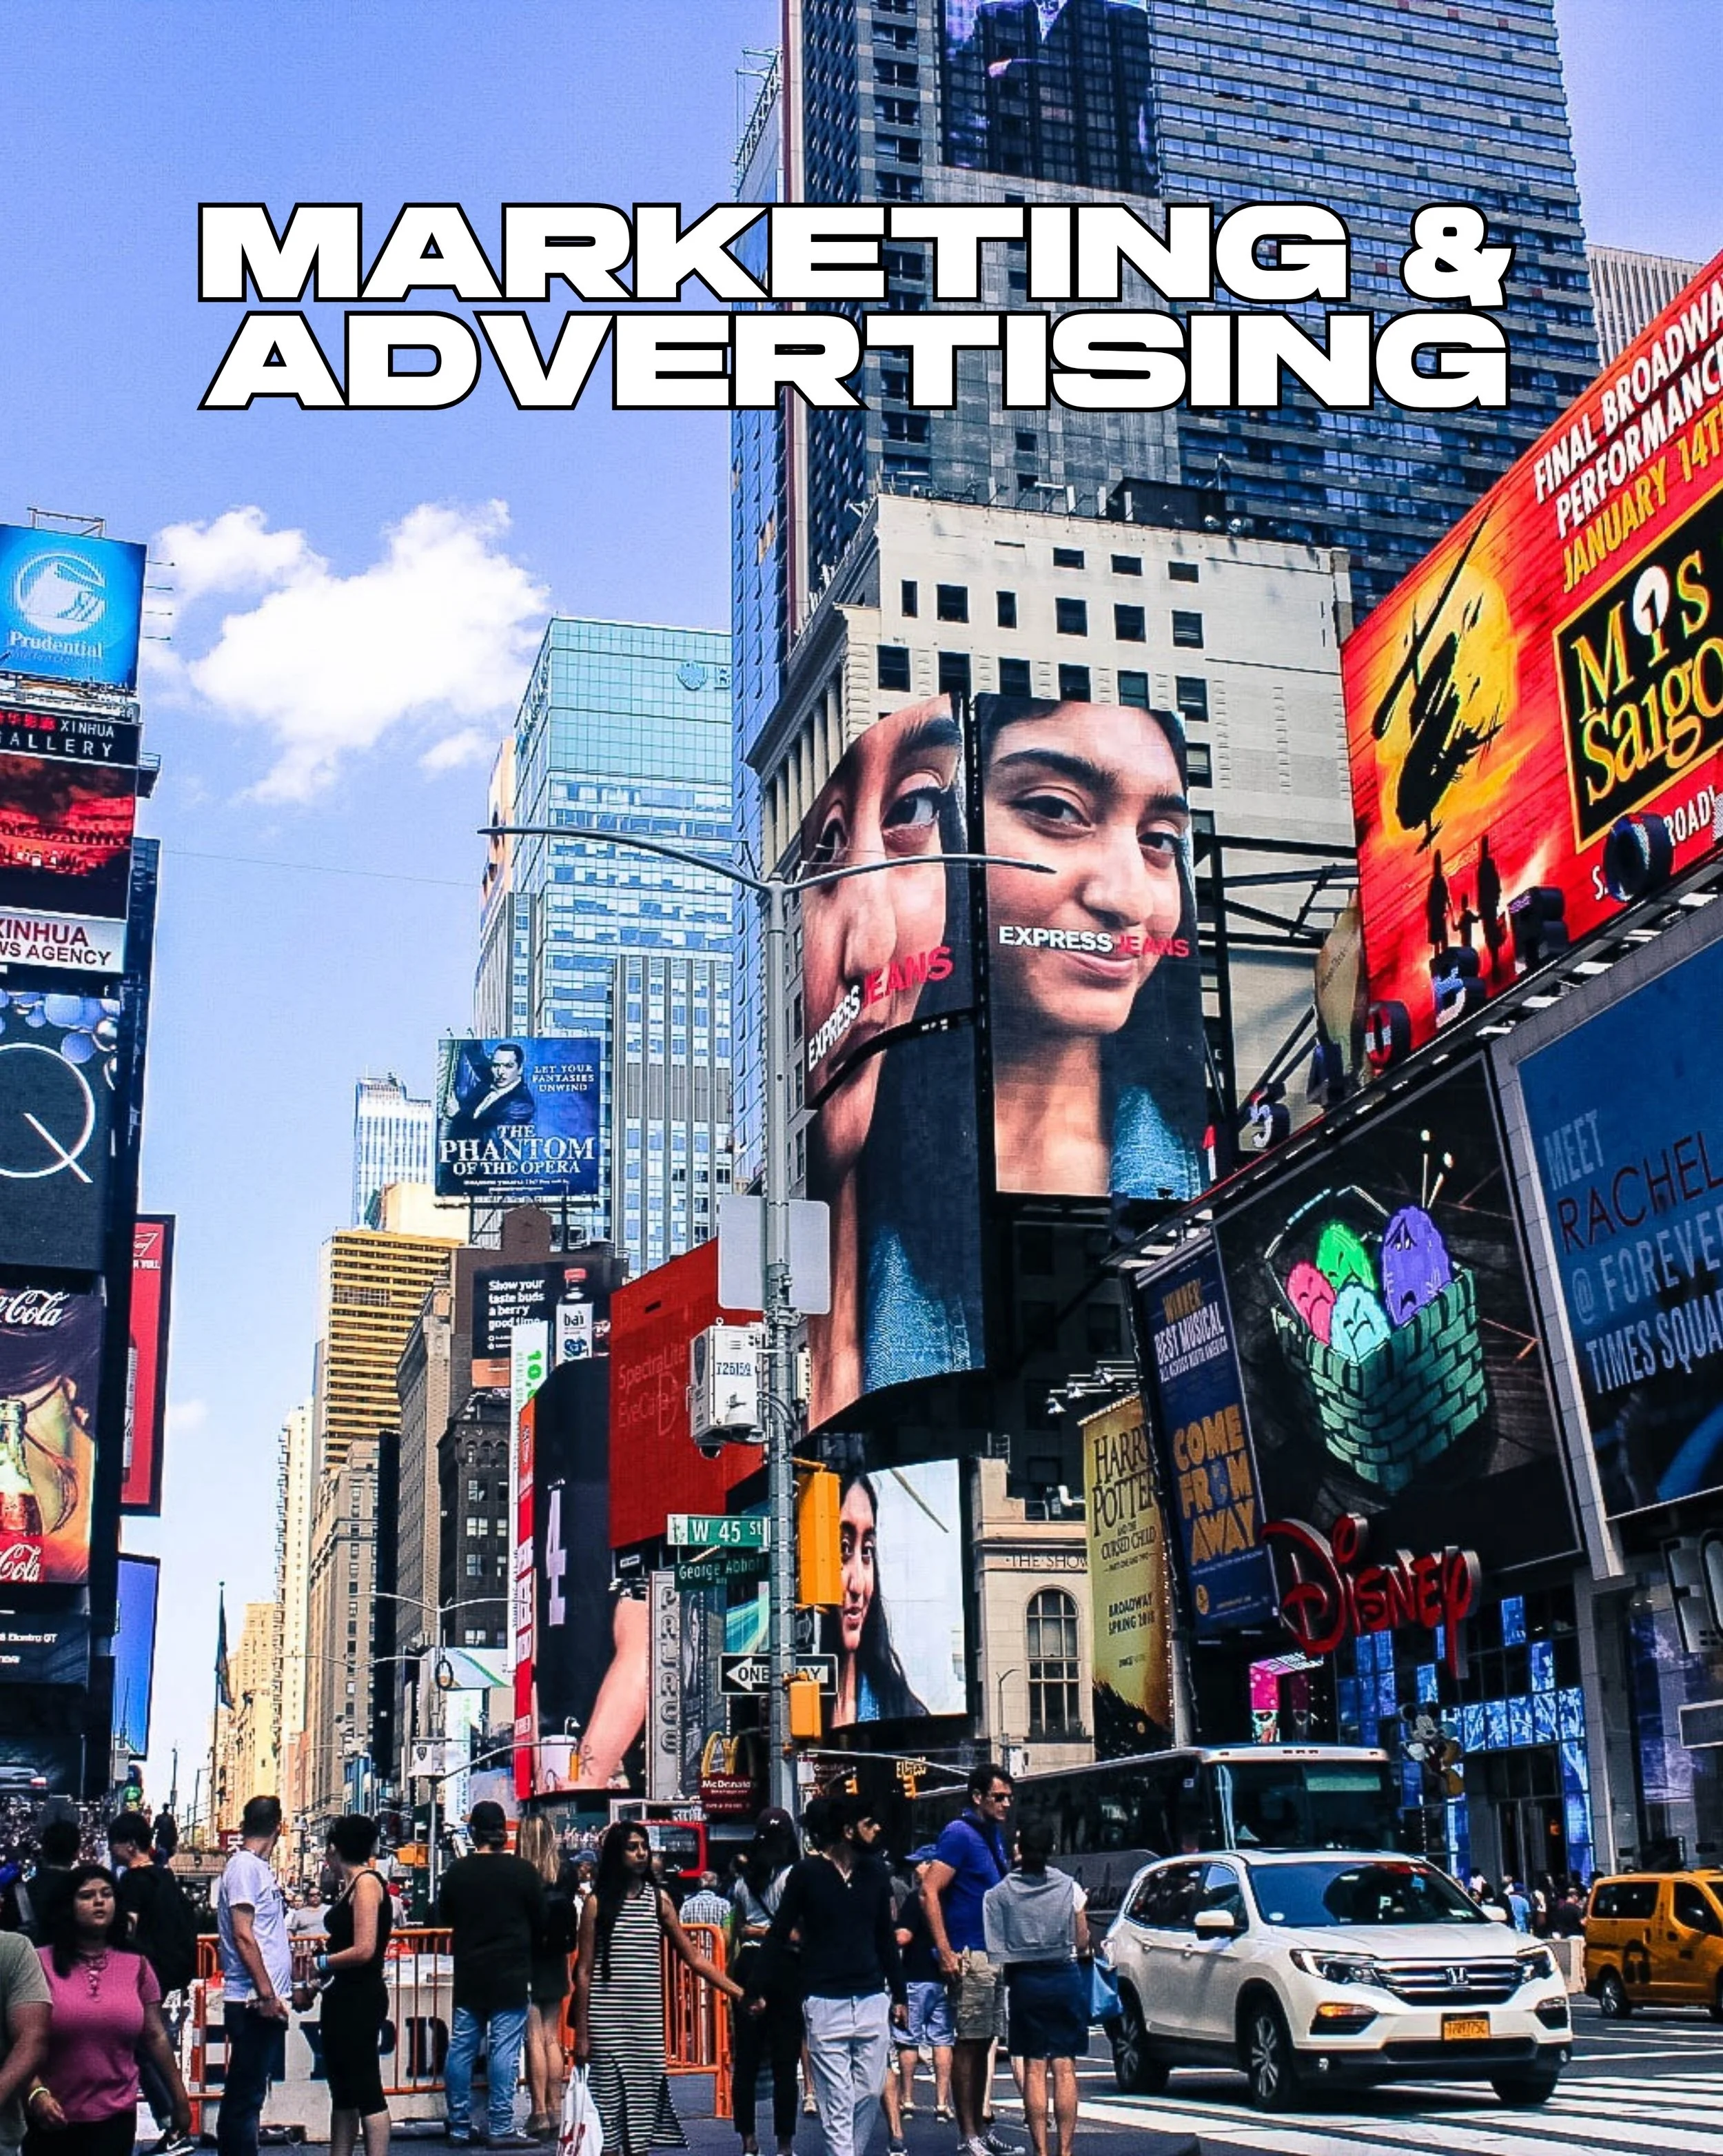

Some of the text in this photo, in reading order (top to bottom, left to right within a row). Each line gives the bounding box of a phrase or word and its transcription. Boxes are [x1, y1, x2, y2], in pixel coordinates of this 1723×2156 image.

[1533, 278, 1723, 505] FINAL BROADWA
[1563, 456, 1667, 593] JANUARY
[10, 630, 103, 658] Prudential
[61, 720, 114, 738] XINHUA
[0, 731, 112, 757] ALLERY
[998, 926, 1190, 957] EXPRESS JEANS
[26, 944, 112, 966] AGENCY
[808, 946, 955, 1072] EXPRESS JEANS
[532, 1074, 594, 1082] FANTASIES
[561, 1064, 593, 1072] YOUR
[497, 1125, 536, 1138] THE
[438, 1137, 596, 1163] PHANTOM
[1544, 1109, 1604, 1191] MEET
[453, 1160, 580, 1176] OF THE OPERA
[1557, 1131, 1723, 1254] RACHEL
[1572, 1203, 1723, 1325] @ FOREVE
[488, 1280, 544, 1291] Show your
[488, 1292, 544, 1304] taste buds
[488, 1305, 529, 1316] a berry
[564, 1310, 584, 1326] bai
[1154, 1301, 1224, 1365] BEST MUSICAL
[1586, 1288, 1723, 1394] TIMES SQUA
[1174, 1404, 1245, 1472] COME
[1094, 1424, 1148, 1485] HARR
[692, 1520, 762, 1543] W 45 St
[1131, 1525, 1156, 1549] CHILD
[1191, 1499, 1255, 1565] AWAY
[679, 1564, 722, 1581] George
[1012, 1555, 1040, 1567] THE
[1109, 1591, 1153, 1618] BROADWAY
[1109, 1616, 1136, 1636] SPRING
[660, 1586, 677, 1752] PALACE
[738, 1665, 769, 1681] ONE
